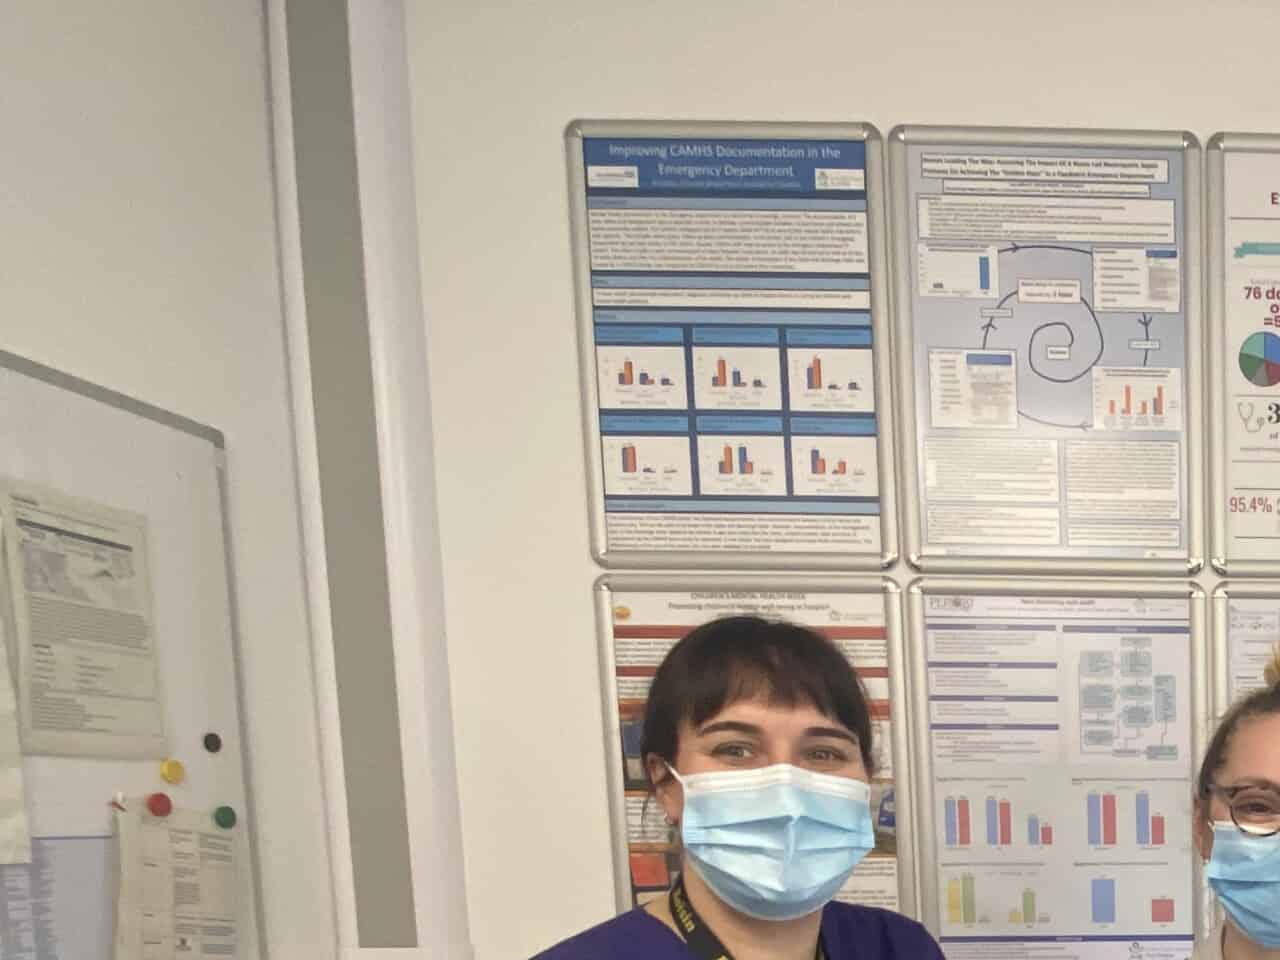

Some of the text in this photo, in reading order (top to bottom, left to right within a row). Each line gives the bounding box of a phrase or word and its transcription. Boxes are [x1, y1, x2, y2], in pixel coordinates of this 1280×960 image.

[609, 144, 841, 160] Improving CAMHS Documentation in the
[657, 163, 794, 179] Emergency Department
[1244, 286, 1262, 300] 76
[1230, 496, 1273, 514] 95.4%
